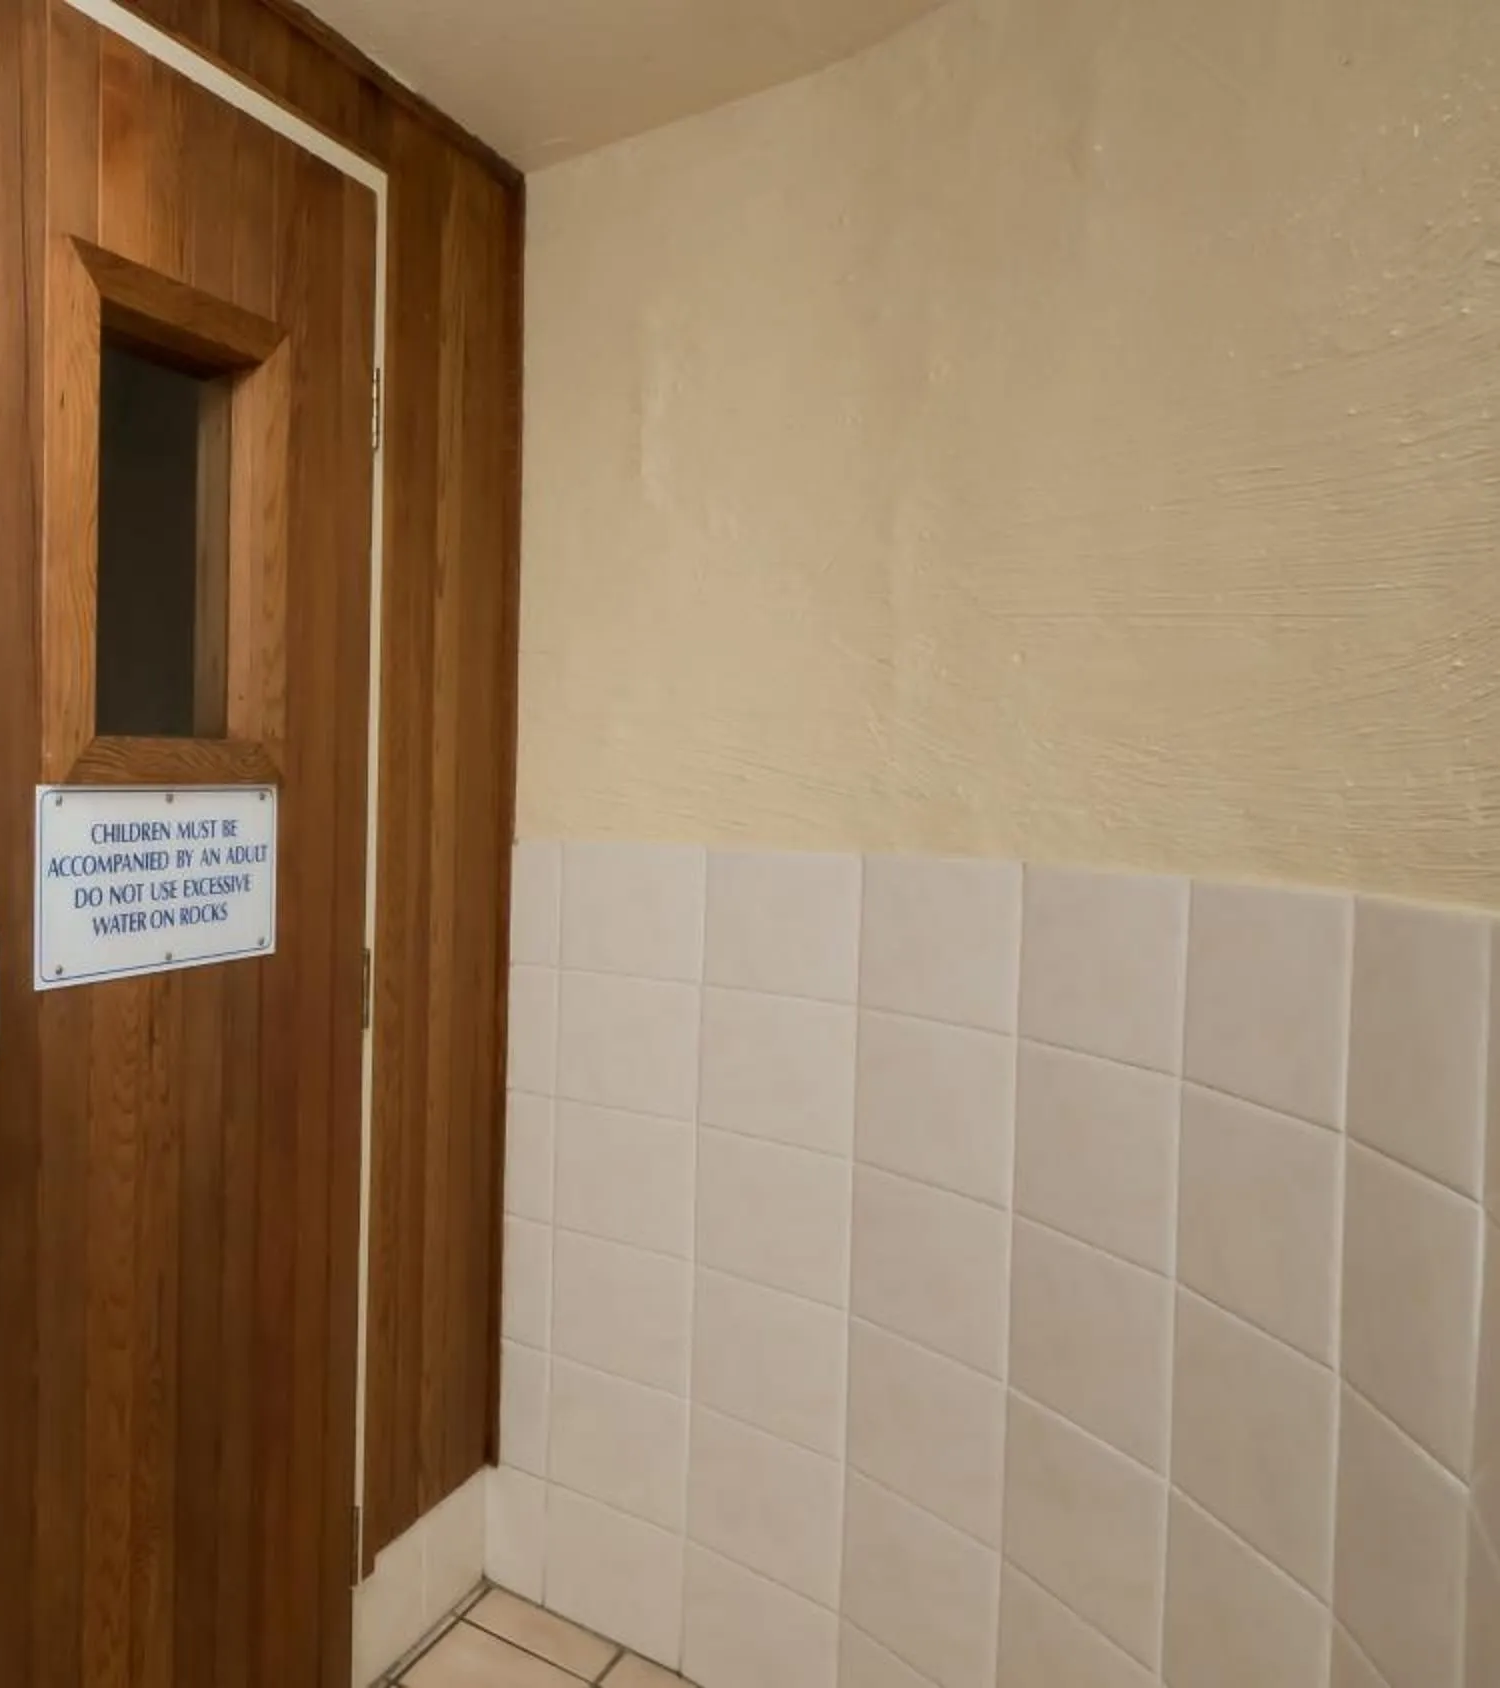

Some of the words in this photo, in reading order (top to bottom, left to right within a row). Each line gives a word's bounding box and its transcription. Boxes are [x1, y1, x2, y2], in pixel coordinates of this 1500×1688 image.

[91, 822, 170, 844] CHILDREN
[177, 821, 217, 840] MUST
[223, 820, 238, 837] BE
[48, 852, 169, 878] ACCOMPANIED
[177, 850, 194, 869] BY
[201, 847, 220, 865] AN
[226, 845, 267, 863] ADULT
[75, 887, 102, 908] DO
[110, 884, 144, 905] NOT
[151, 881, 177, 900] USE
[184, 874, 252, 898] EXCESSIVE
[93, 912, 147, 936] WATER
[150, 910, 174, 929] ON
[180, 904, 228, 925] ROCKS
